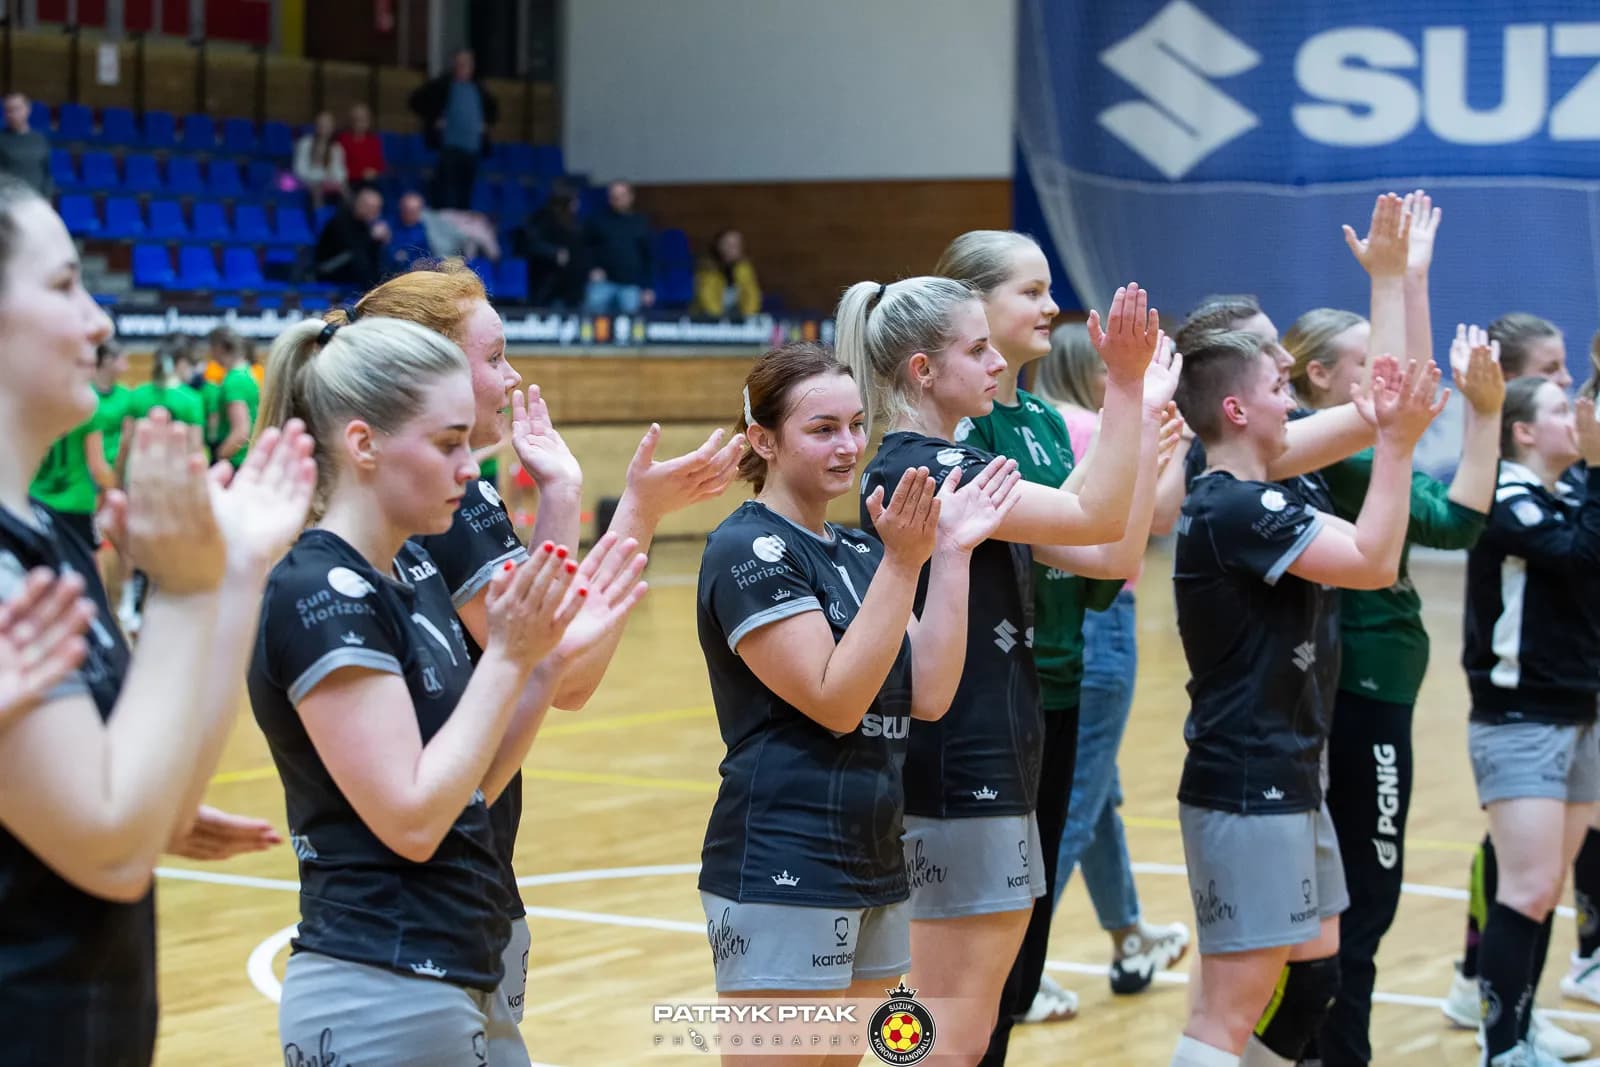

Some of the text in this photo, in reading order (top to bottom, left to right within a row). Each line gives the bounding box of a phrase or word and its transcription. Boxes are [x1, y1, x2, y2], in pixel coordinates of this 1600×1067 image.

[461, 503, 489, 521] Sun
[730, 560, 757, 578] Sun
[296, 589, 331, 615] Sun
